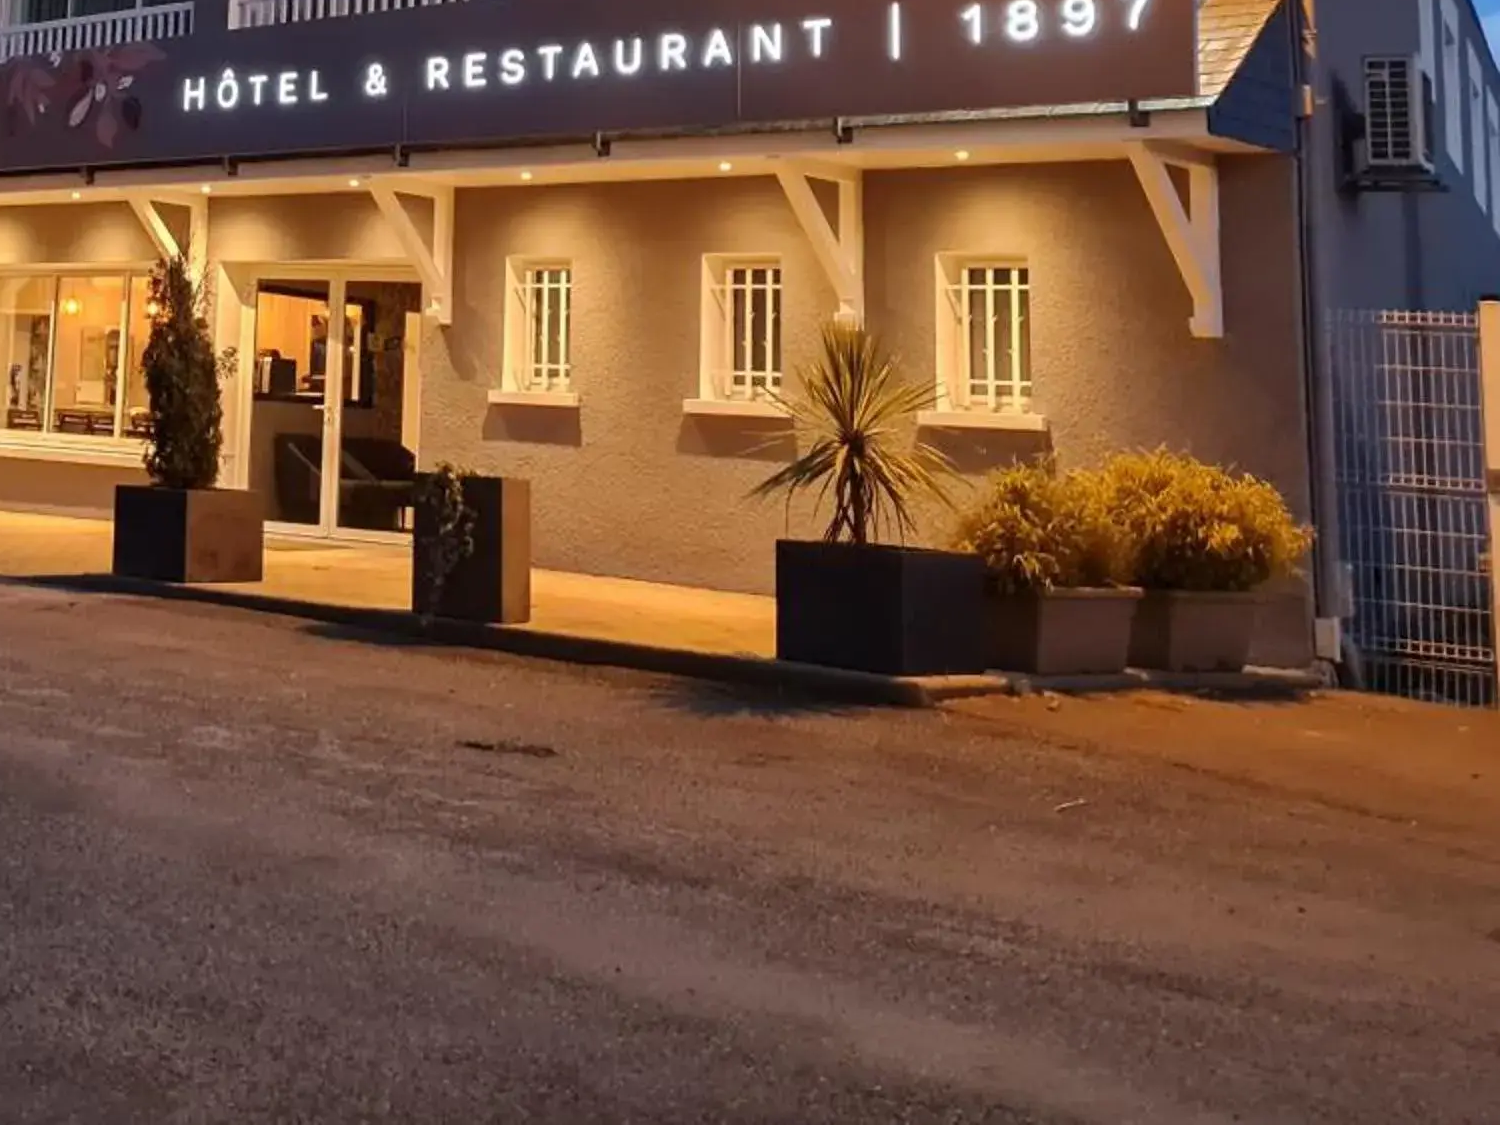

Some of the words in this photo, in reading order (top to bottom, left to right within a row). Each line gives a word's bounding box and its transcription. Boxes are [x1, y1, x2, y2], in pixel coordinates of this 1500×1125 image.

[182, 68, 329, 112] HÔTEL
[365, 62, 388, 97] &
[427, 18, 832, 91] RESTAURANT
